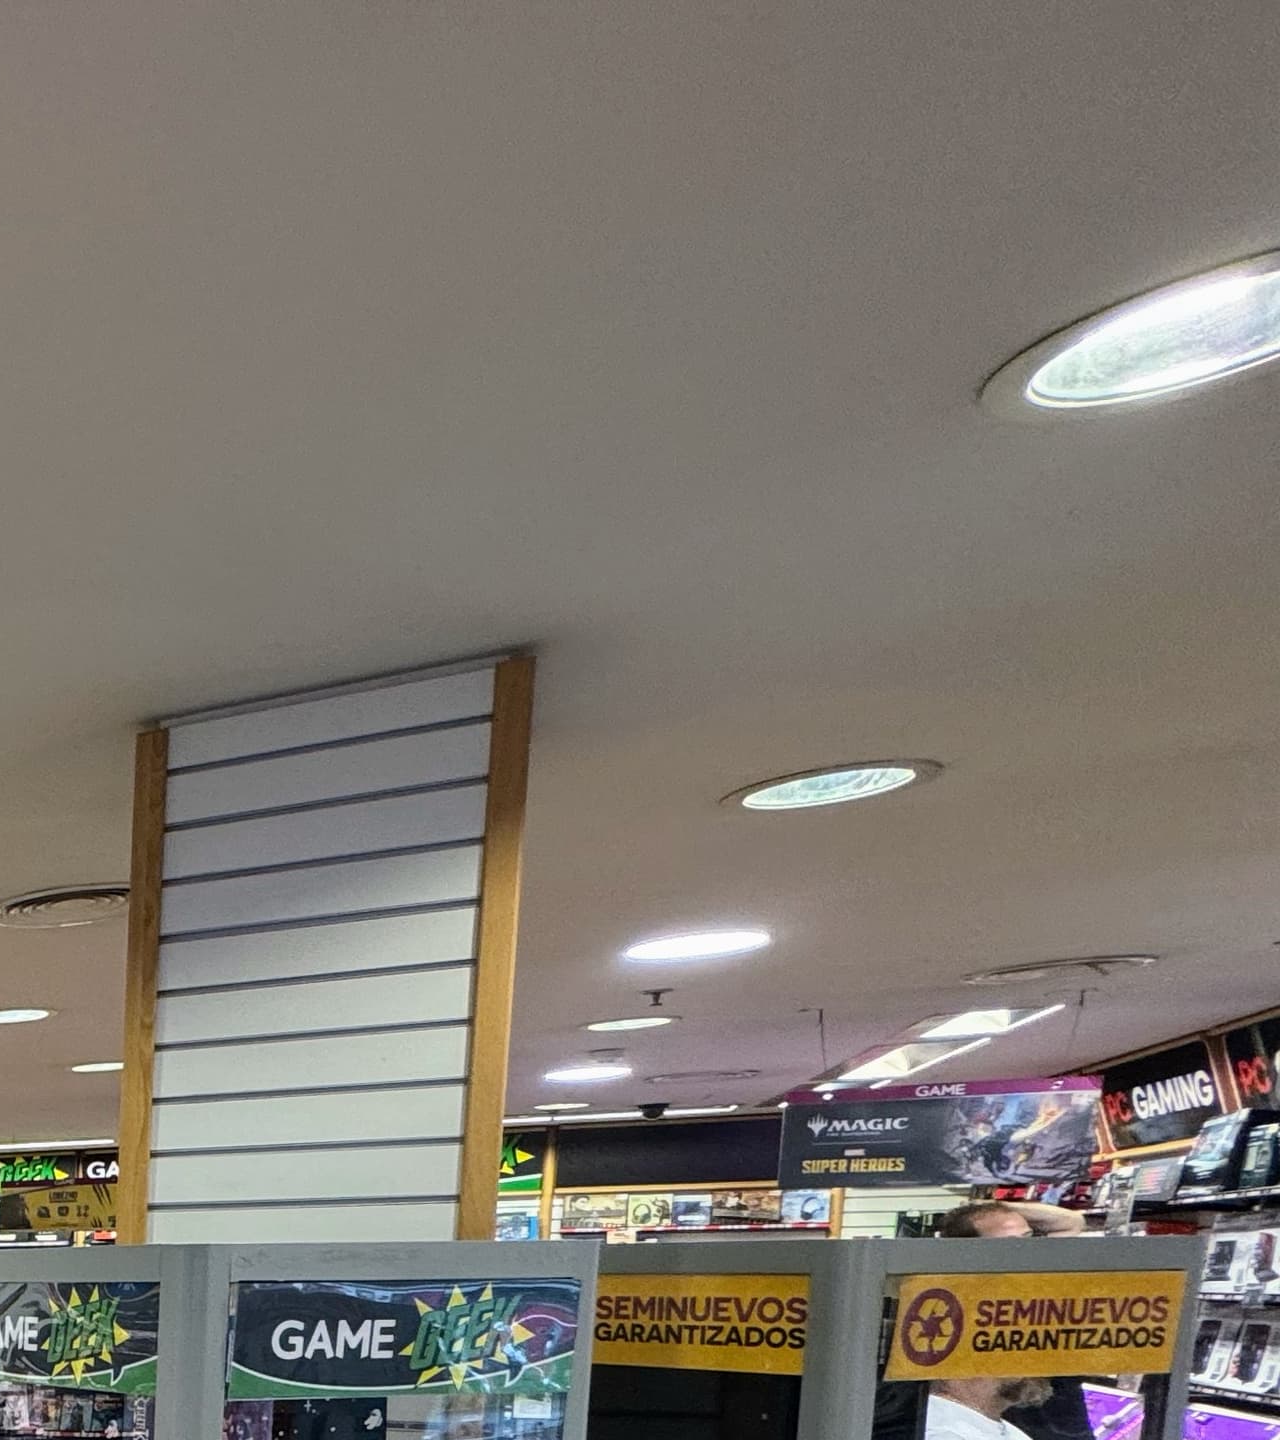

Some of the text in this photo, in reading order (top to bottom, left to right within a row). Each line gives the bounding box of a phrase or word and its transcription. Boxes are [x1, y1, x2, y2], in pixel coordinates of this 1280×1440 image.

[1237, 1056, 1272, 1095] PC
[915, 1084, 966, 1097] GAME
[1104, 1070, 1215, 1124] PC GAMING
[827, 1117, 908, 1132] MAGIC
[87, 1162, 119, 1179] GA
[802, 1157, 905, 1174] SUPER HEROES
[595, 1295, 808, 1324] SEMINUEVOS
[975, 1296, 1170, 1326] SEMINUEVOS
[271, 1319, 395, 1360] GAME
[594, 1323, 806, 1349] GARANTIZADOS
[972, 1326, 1166, 1352] GARANTIZADOS
